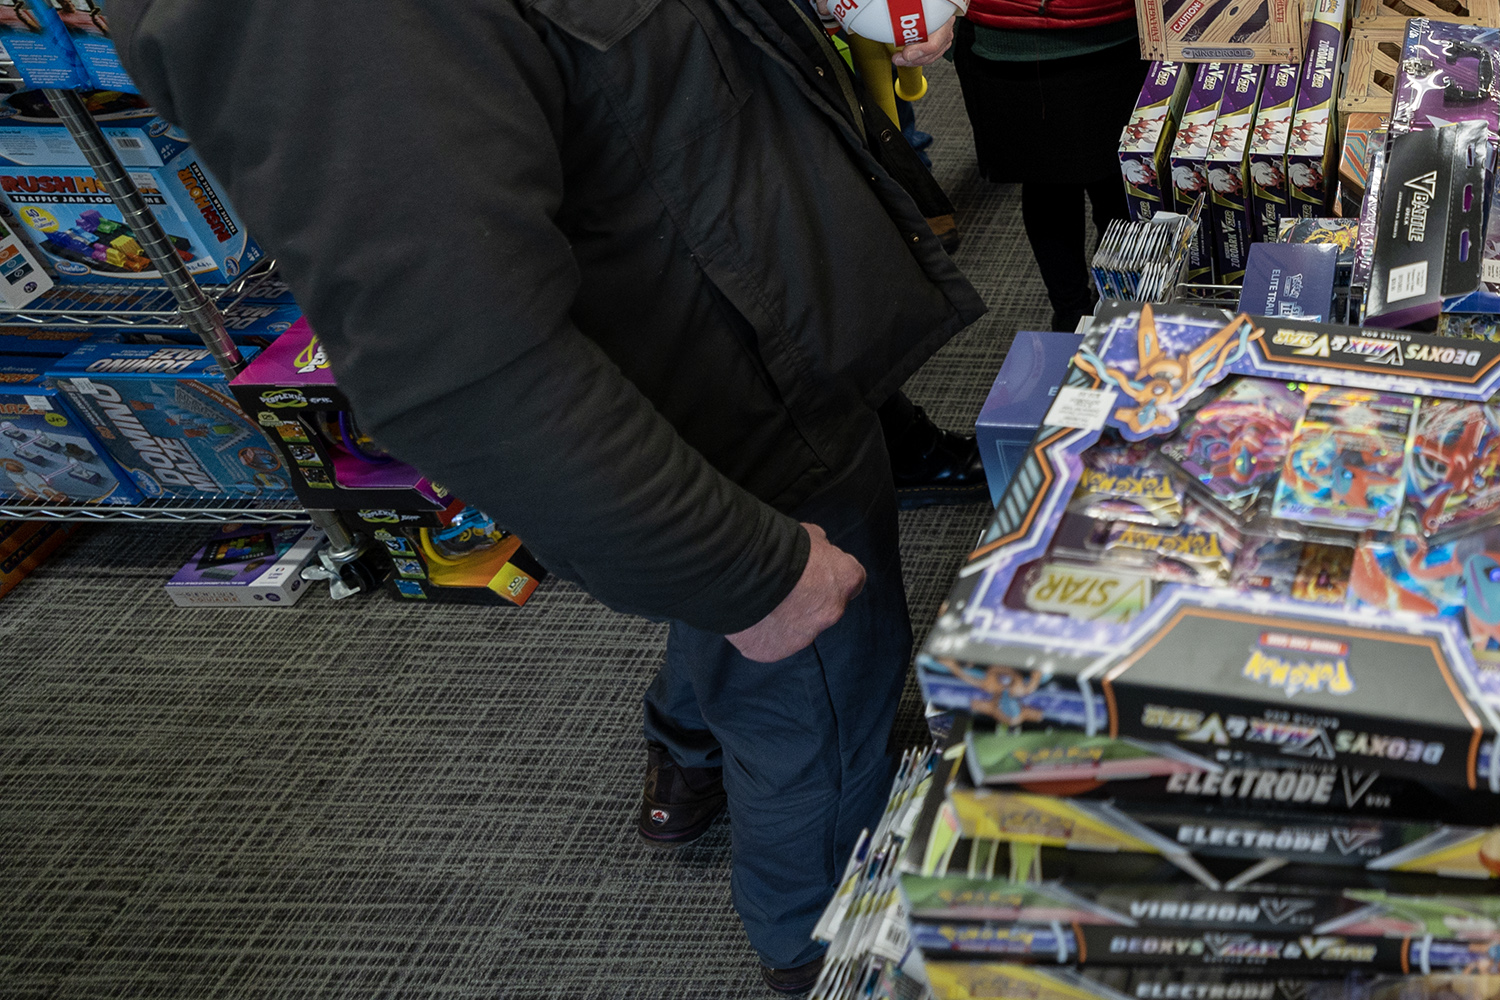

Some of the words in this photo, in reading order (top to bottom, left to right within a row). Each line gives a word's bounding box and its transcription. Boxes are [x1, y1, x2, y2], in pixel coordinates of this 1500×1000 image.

[1172, 1, 1202, 32] CAUTION:
[1192, 49, 1215, 58] KING
[1315, 36, 1331, 68] ZOROARK
[0, 176, 75, 194] RUSH
[178, 166, 209, 211] HOUR
[13, 195, 59, 204] TRAFFIC
[61, 196, 88, 204] JAM
[26, 208, 39, 219] 40
[200, 206, 232, 244] RUSH
[1408, 191, 1435, 244] BATTLE
[1229, 231, 1241, 269] ZOROARK
[1272, 269, 1281, 292] ELITE
[1331, 335, 1348, 352] &
[1361, 330, 1379, 338] BOX
[1380, 332, 1412, 342] BATTLE
[86, 358, 188, 374] DOMINO
[150, 348, 212, 362] MAZE
[1406, 343, 1481, 367] DEOXYS
[259, 392, 307, 406] PERPLEXUS
[92, 381, 191, 487] DOMINO
[162, 436, 224, 494] MAZE
[1242, 650, 1354, 694] Pokémon
[1335, 730, 1446, 765] DEOXYS
[1165, 770, 1337, 804] ELECTRODE
[1342, 766, 1380, 809] V
[1177, 824, 1330, 852] ELECTRODE
[1129, 900, 1261, 923] VIRIZION
[1109, 936, 1204, 956] DEOXYS
[1135, 982, 1276, 998] ELECTRODE
